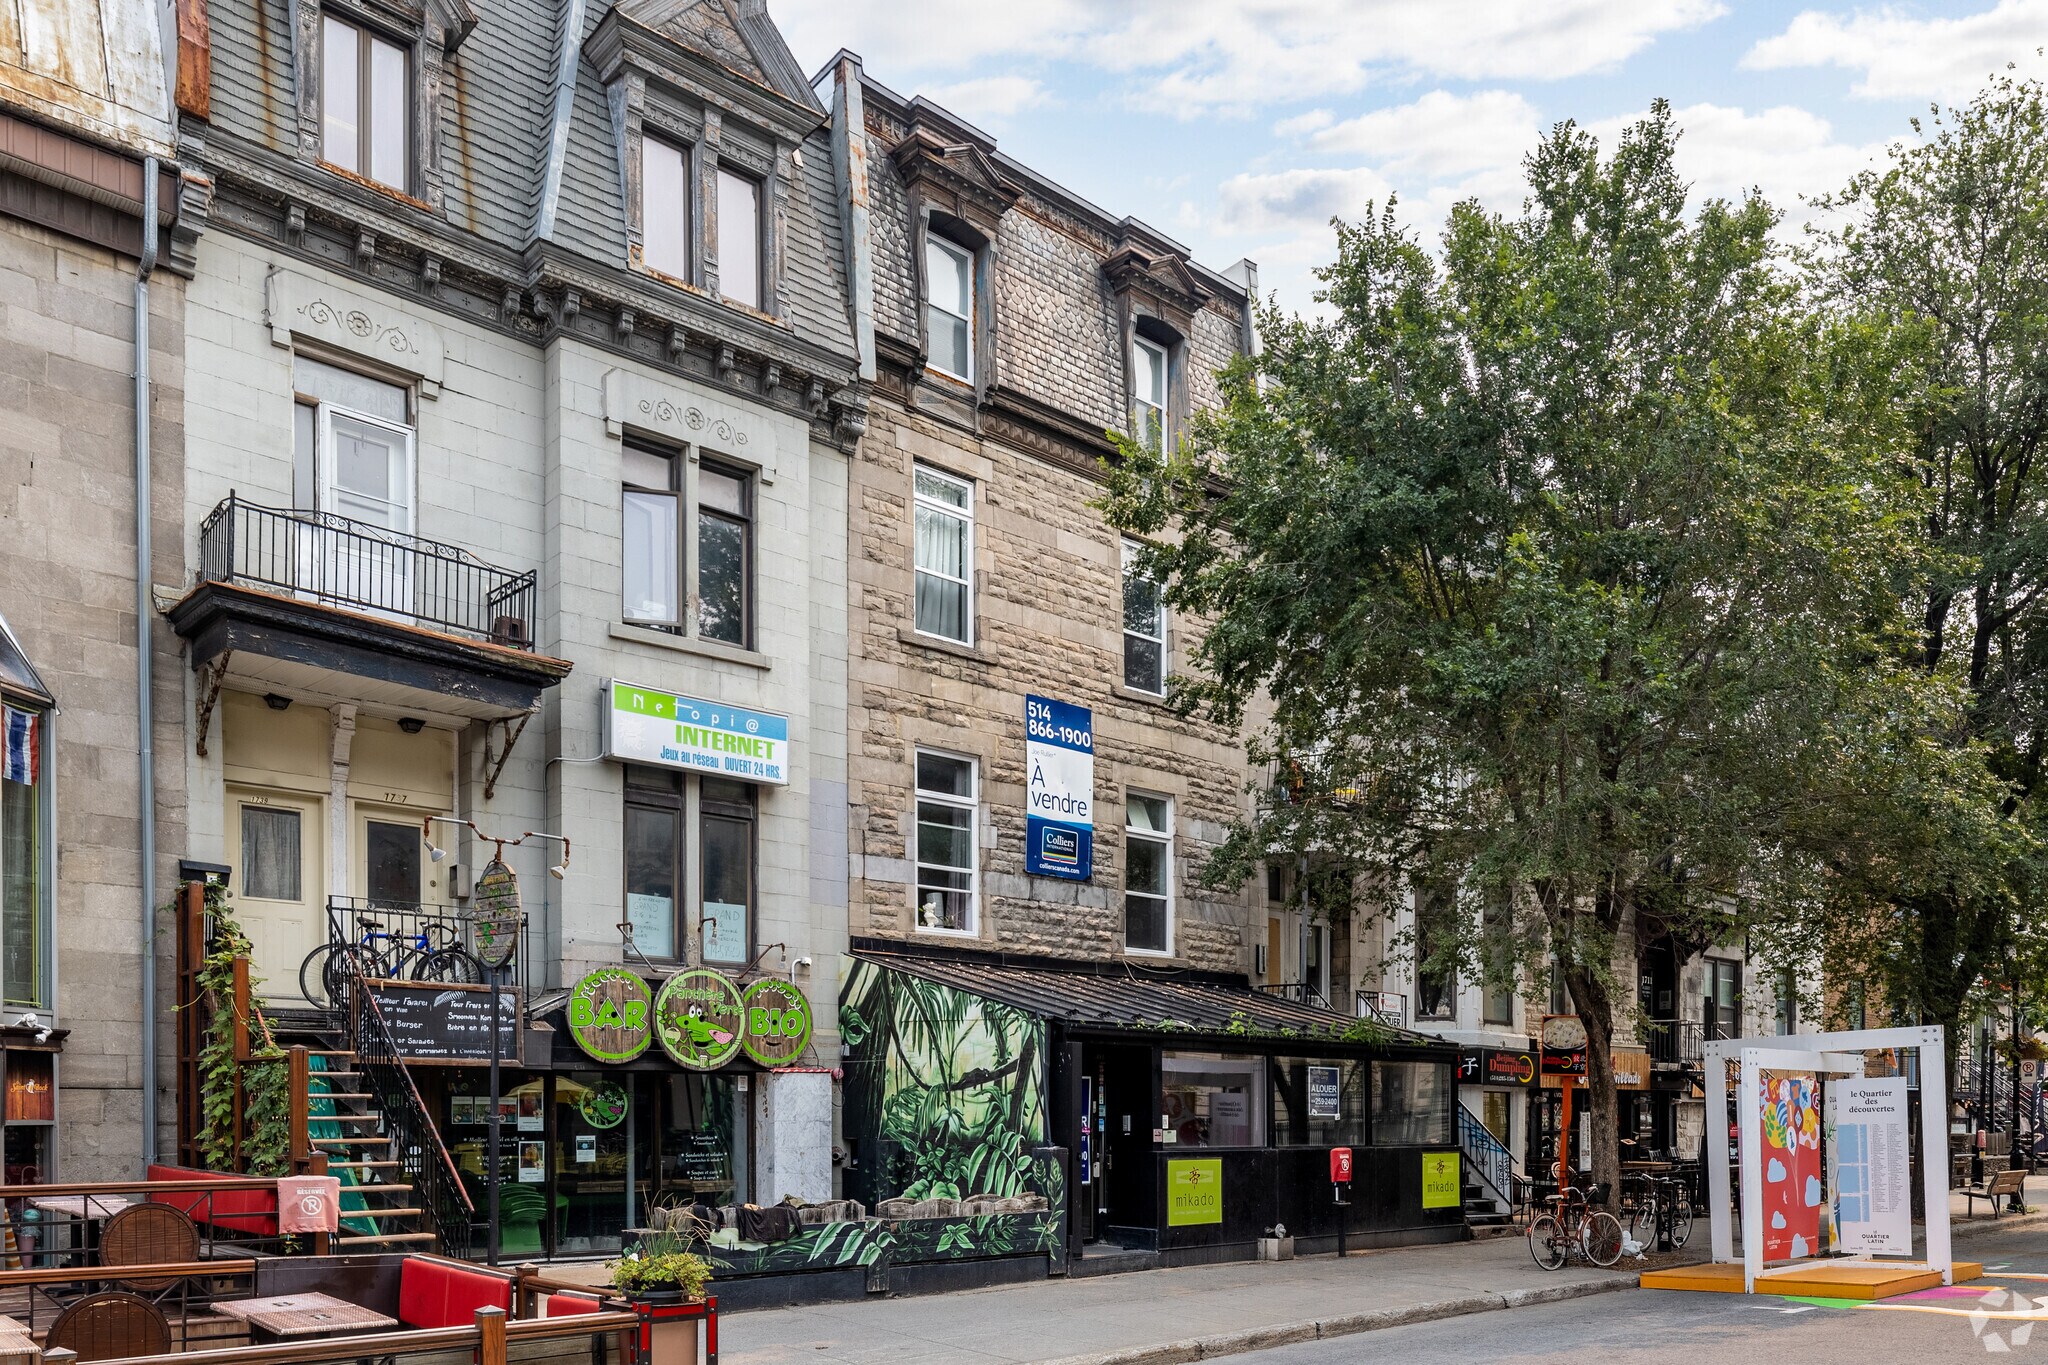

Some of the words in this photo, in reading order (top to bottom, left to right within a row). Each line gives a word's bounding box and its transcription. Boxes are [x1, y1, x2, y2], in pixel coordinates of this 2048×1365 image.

[1028, 701, 1051, 721] 514
[675, 724, 776, 760] INTERNET
[1029, 719, 1091, 748] 866-1900
[660, 745, 679, 762] Jeux
[681, 751, 691, 763] au
[692, 752, 719, 769] réseau
[724, 756, 752, 774] OUVERT
[754, 761, 764, 776] 24
[765, 763, 782, 779] HRS.
[1031, 757, 1046, 788] À
[1031, 790, 1088, 817] vendre
[1046, 833, 1075, 848] Colliers
[1046, 844, 1074, 853] INTERNATIONAL
[1039, 862, 1080, 875] collierscanada.com
[668, 985, 726, 1002] Panthère
[570, 997, 648, 1032] BAR
[708, 1000, 744, 1019] Verte
[396, 1020, 423, 1029] Burger
[749, 1006, 805, 1038] BIO
[1462, 1057, 1479, 1076] 子
[1489, 1058, 1531, 1077] Dumpling
[1496, 1053, 1516, 1064] Beijing
[1859, 1090, 1893, 1099] Quartier
[1849, 1105, 1895, 1113] découvertes
[1428, 1181, 1455, 1193] mikado
[1176, 1193, 1214, 1207] mikado
